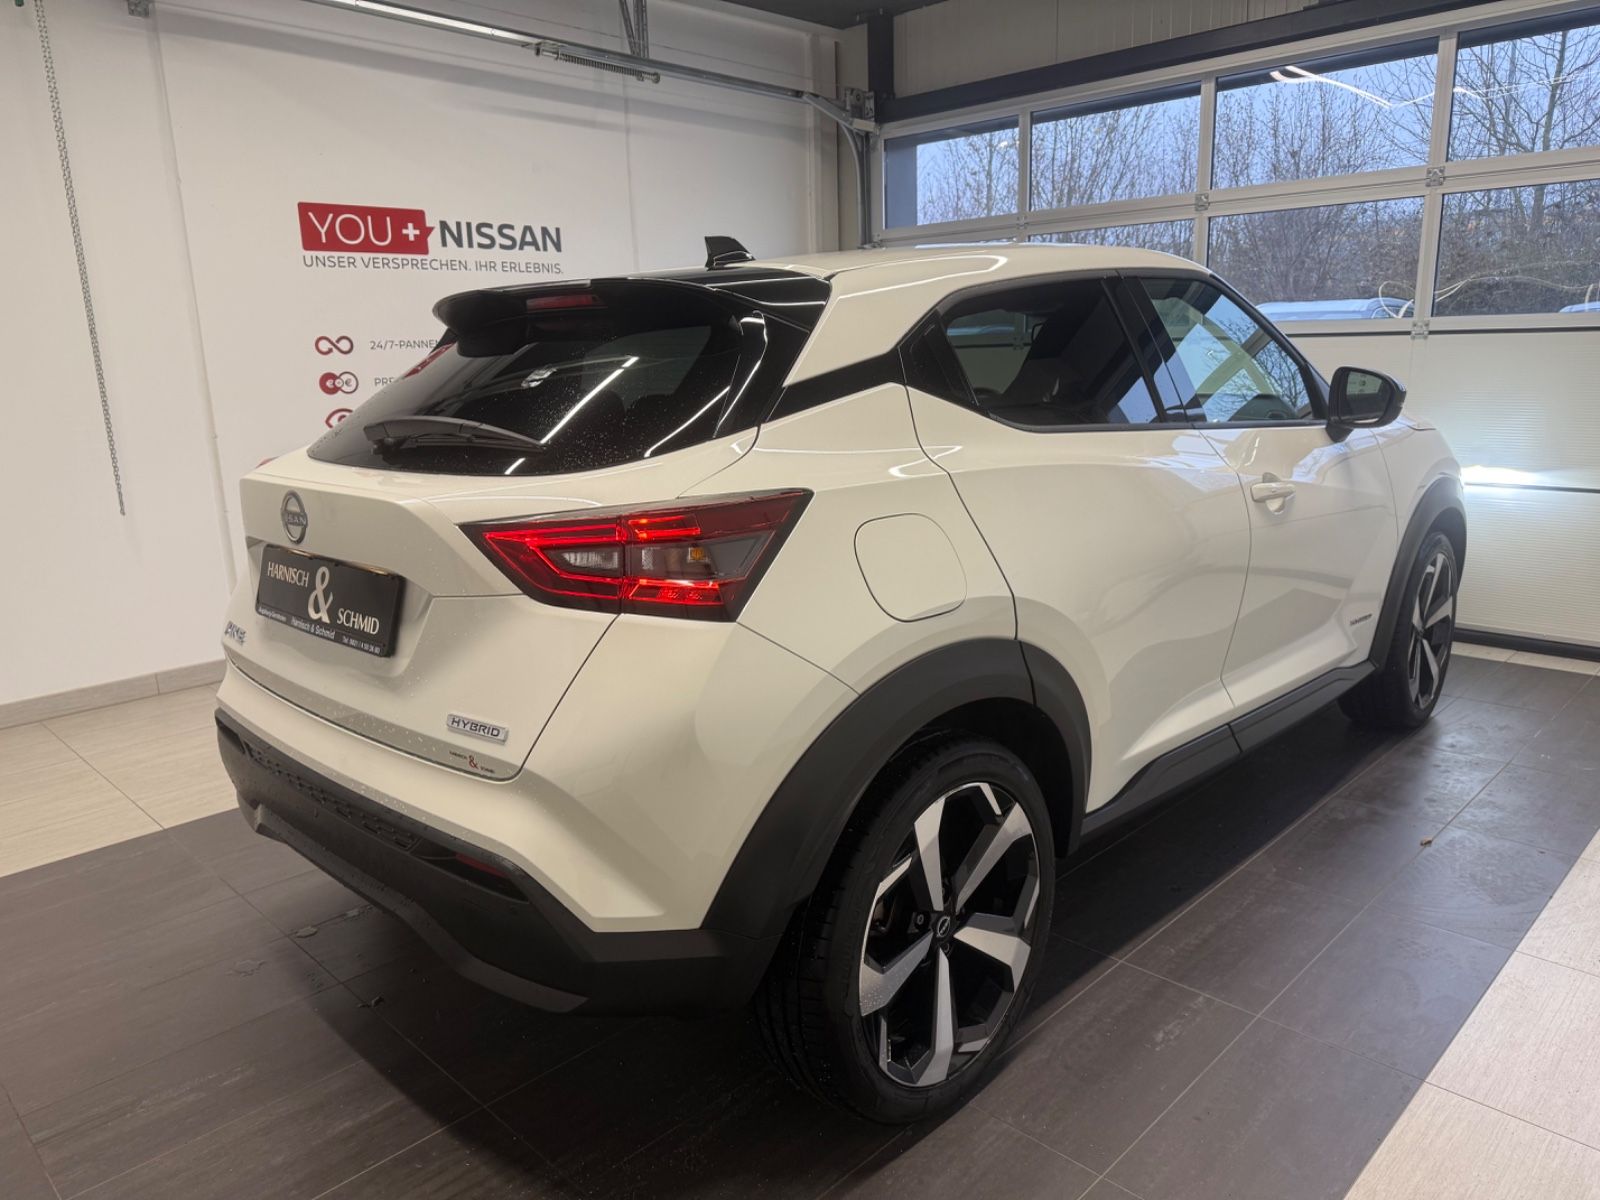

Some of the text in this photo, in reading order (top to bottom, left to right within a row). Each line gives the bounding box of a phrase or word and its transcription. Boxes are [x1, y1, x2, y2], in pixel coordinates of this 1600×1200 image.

[308, 211, 392, 247] YOU
[438, 220, 563, 253] NISSAN
[302, 255, 564, 275] UNSER VERSPRECHEN. IHR ERLEBNIS.
[267, 561, 310, 587] HARNISCH
[307, 565, 334, 624] &
[336, 607, 380, 635] SCHMID
[451, 717, 500, 736] HYBRID
